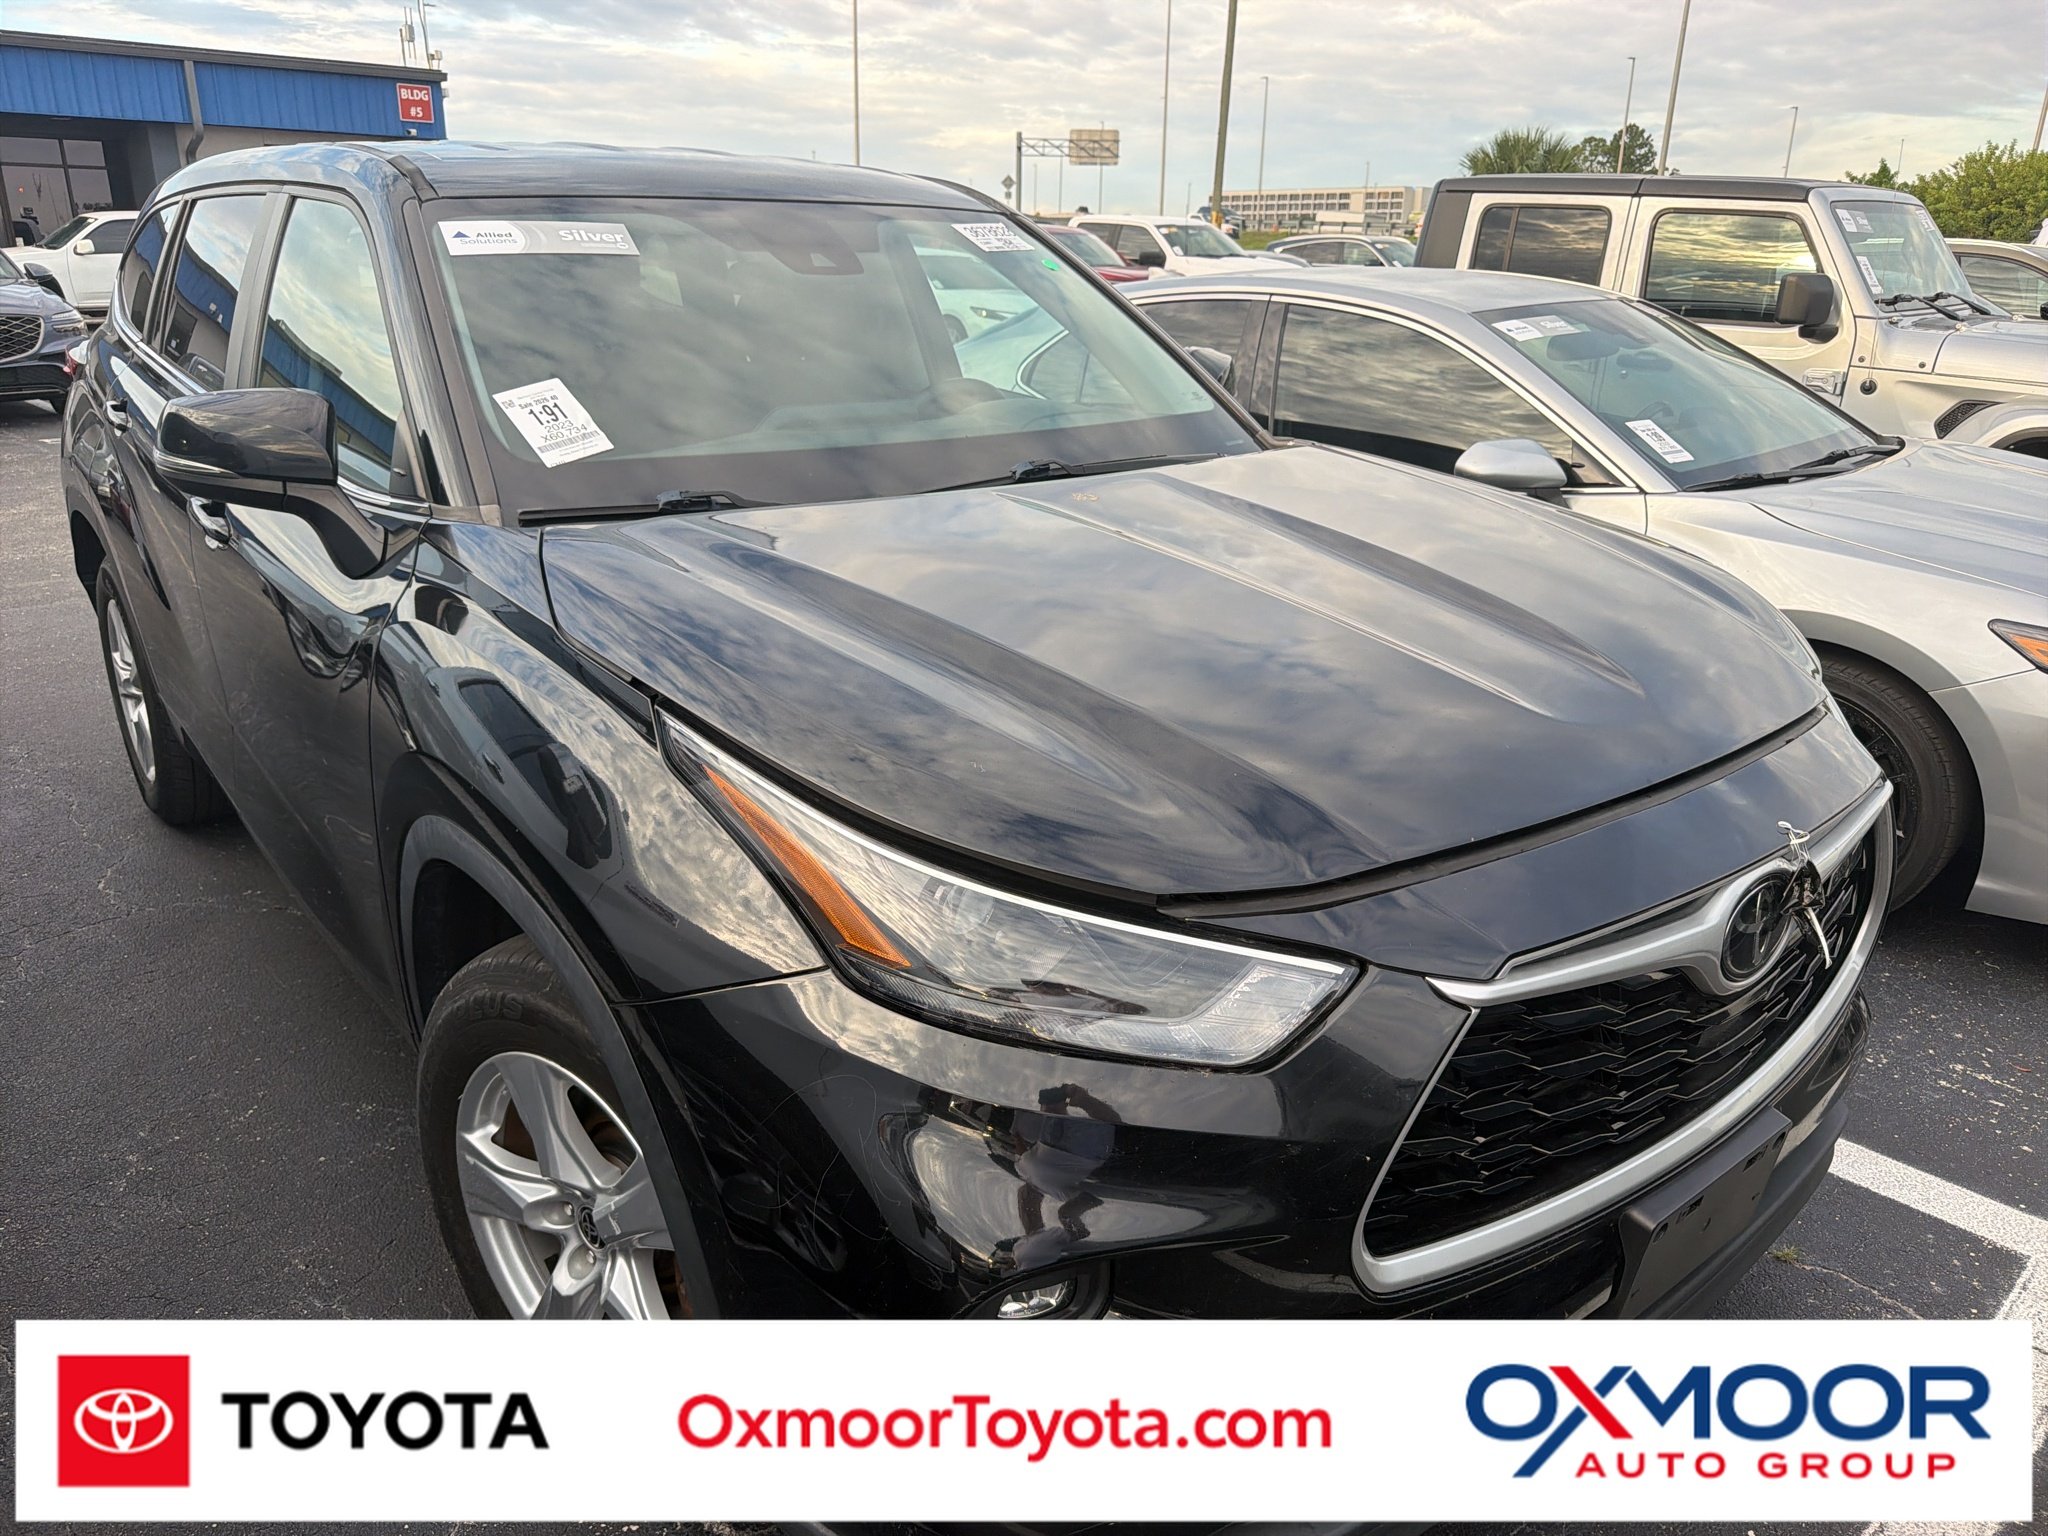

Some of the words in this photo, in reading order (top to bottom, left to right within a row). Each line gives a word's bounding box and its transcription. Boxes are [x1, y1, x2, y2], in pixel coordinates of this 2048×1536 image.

[400, 88, 429, 101] BLDG
[410, 106, 423, 118] #5
[459, 237, 518, 245] Solutions
[475, 231, 513, 239] Allied
[558, 229, 624, 242] Silver
[528, 402, 568, 425] 1:91
[545, 420, 574, 433] 2023
[541, 424, 588, 443] X60,734
